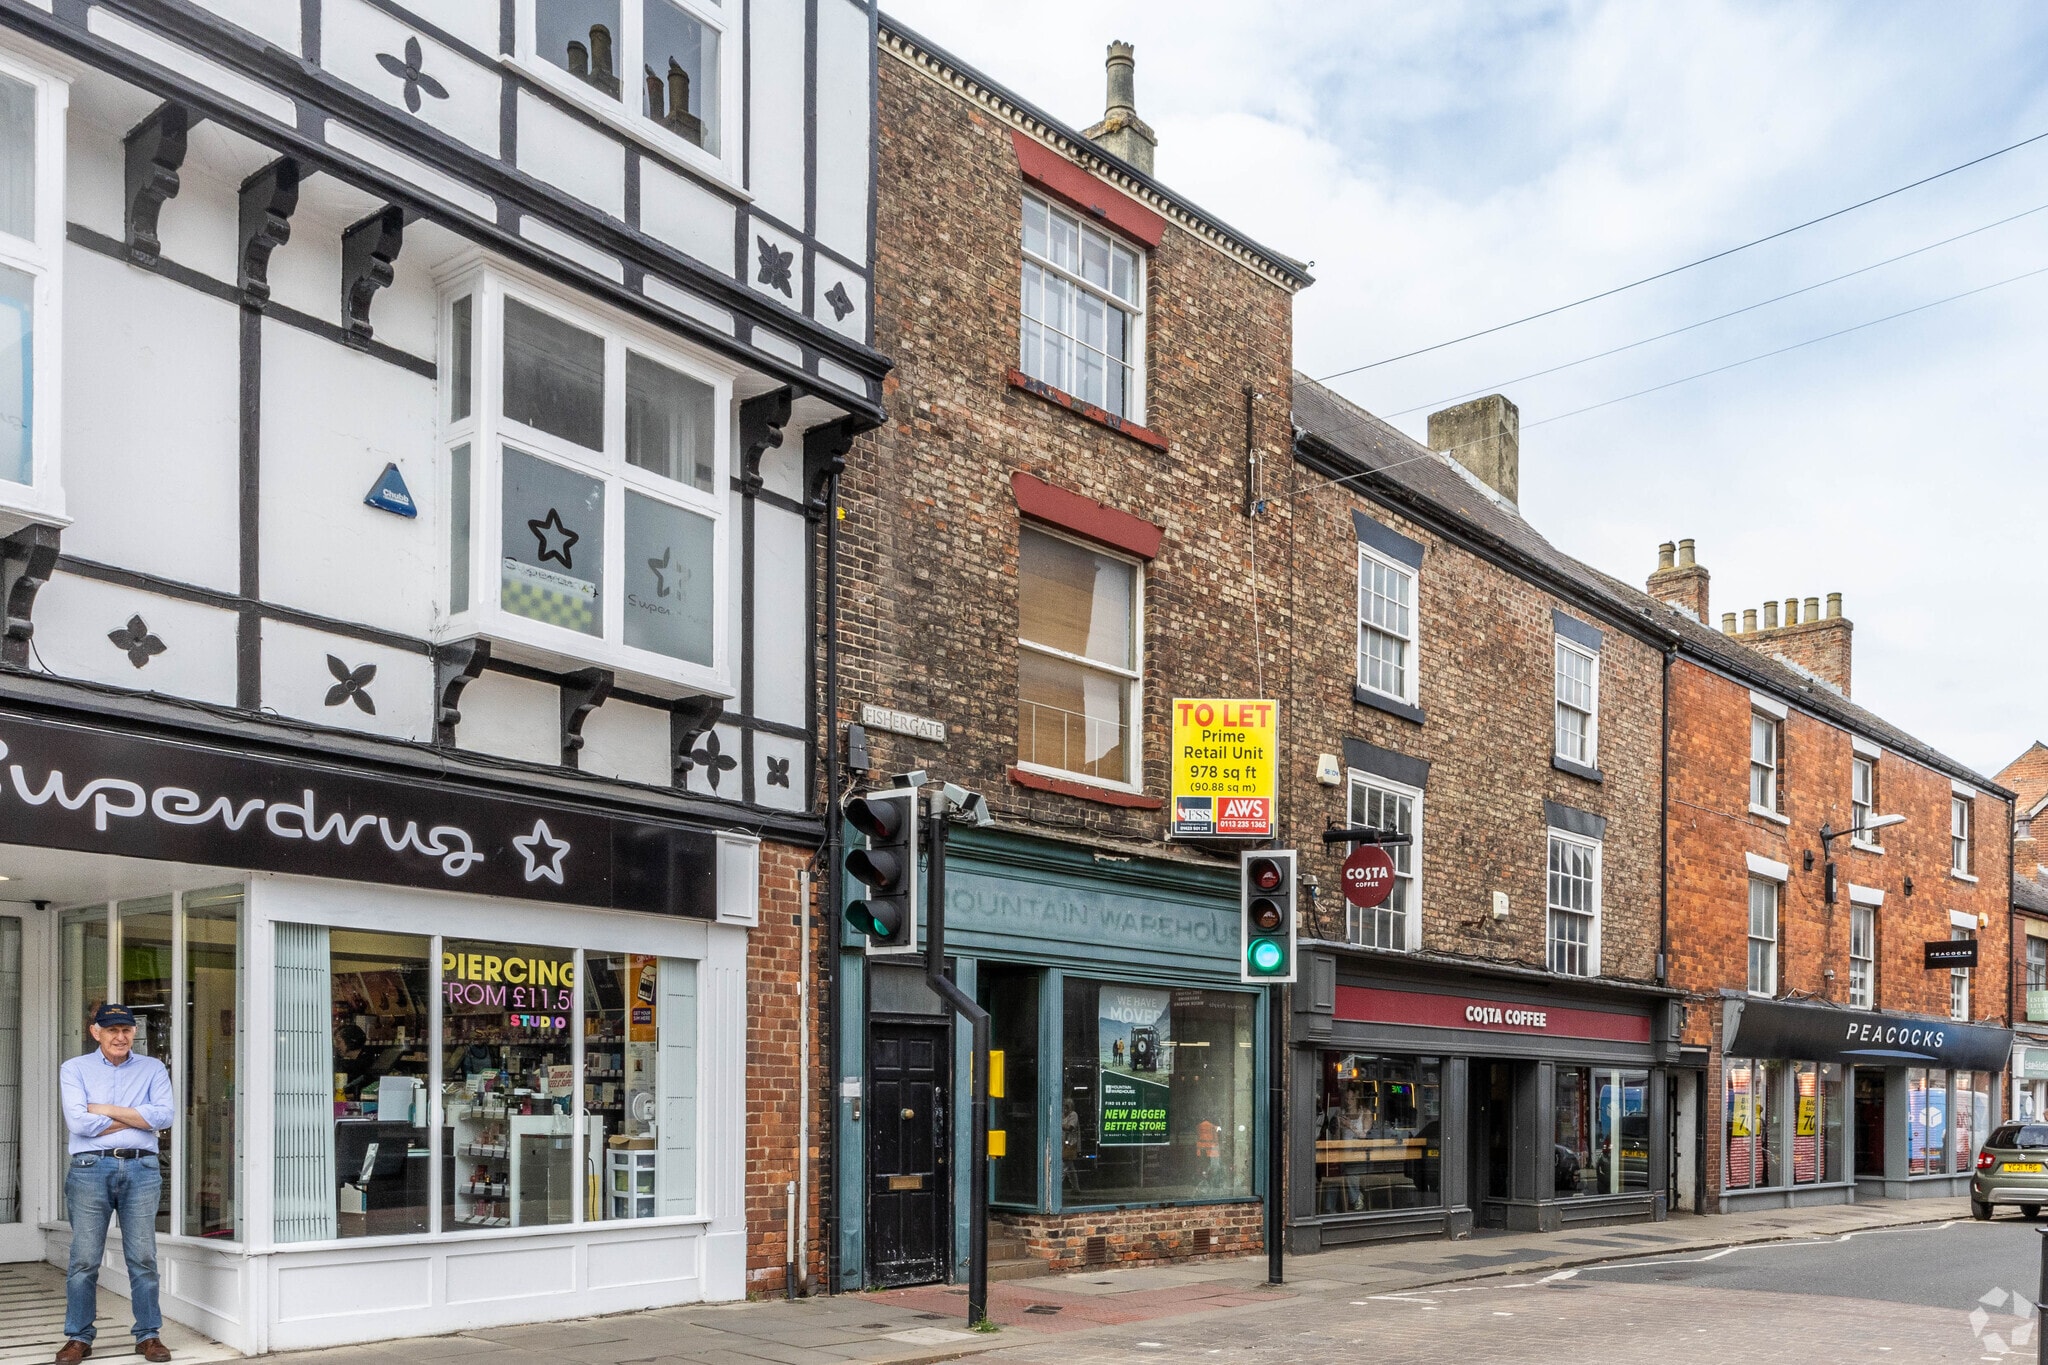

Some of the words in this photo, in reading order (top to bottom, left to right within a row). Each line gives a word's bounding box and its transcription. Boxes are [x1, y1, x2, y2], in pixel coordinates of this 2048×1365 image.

[383, 488, 409, 503] Chubb
[865, 707, 942, 738] FISHERGATE
[1178, 703, 1214, 727] TO
[1223, 704, 1271, 728] LET
[1202, 729, 1245, 743] Prime
[1184, 745, 1227, 759] Retail
[1233, 746, 1263, 760] Unit
[1190, 765, 1218, 778] 978
[1223, 768, 1240, 781] sq
[1245, 765, 1257, 779] ft
[1190, 782, 1224, 792] (90.88
[1227, 784, 1239, 793] sq
[1242, 783, 1256, 793] m)
[0, 738, 485, 877] uperdrug
[1224, 799, 1264, 818] AWS
[1220, 820, 1237, 828] 0113
[1237, 820, 1249, 828] 235
[1346, 866, 1389, 880] COSTA
[944, 887, 1089, 926] OUNTAIN
[1099, 904, 1241, 946] WAREHOUS
[1929, 949, 1973, 957] PEACOCKS
[442, 952, 574, 988] PIERCING
[1117, 995, 1132, 1006] WE
[1134, 997, 1157, 1008] HAVE
[510, 1014, 567, 1029] STUDIO
[1465, 1005, 1502, 1025] COSTA
[1504, 1009, 1547, 1027] COFFEE
[1846, 1022, 1945, 1049] PEACOCKS
[1104, 1109, 1129, 1120] NEW
[1130, 1109, 1167, 1120] BIGGER
[1104, 1121, 1138, 1131] BETTER
[1138, 1121, 1167, 1131] STORE
